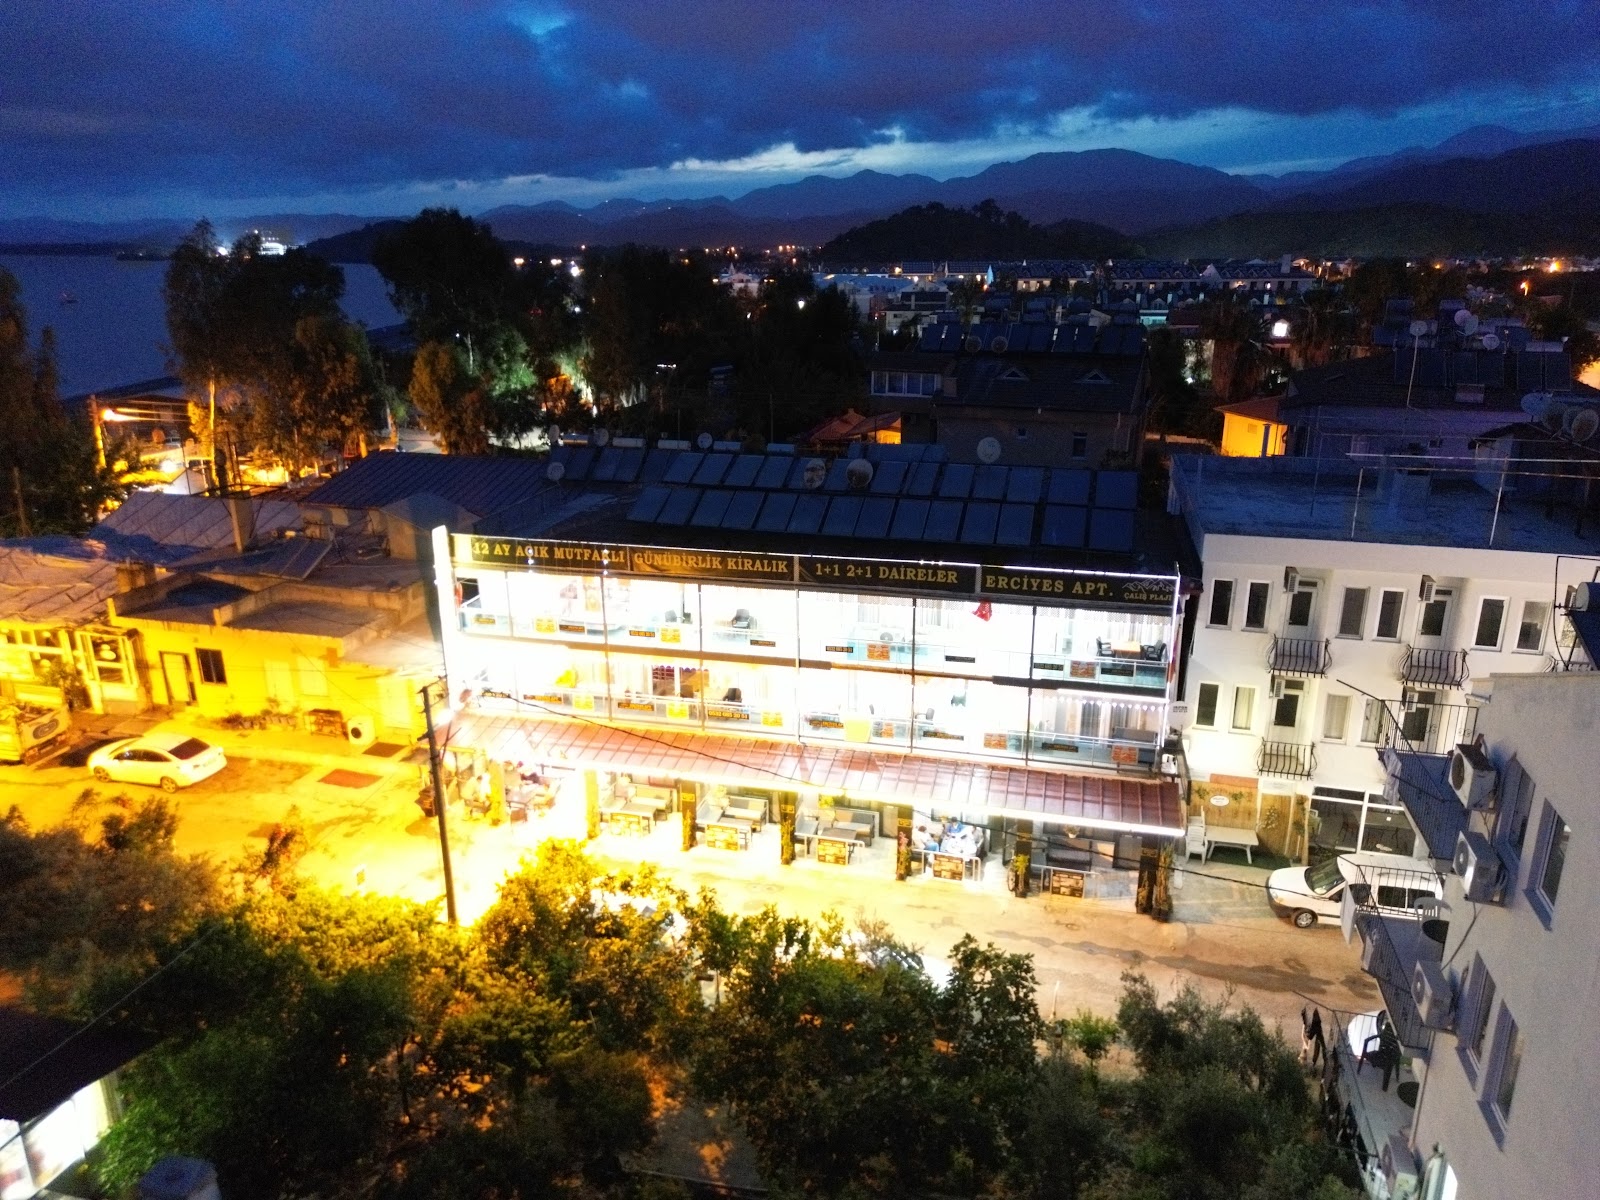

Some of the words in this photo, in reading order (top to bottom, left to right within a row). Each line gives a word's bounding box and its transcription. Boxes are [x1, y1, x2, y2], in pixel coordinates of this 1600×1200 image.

[472, 542, 490, 555] 12
[493, 543, 512, 556] AY
[516, 545, 550, 559] AÇIK
[553, 547, 625, 563] MUTFAKLI
[634, 550, 722, 569] GÜNÜBİRLİK
[727, 556, 789, 573] KİRALIK
[815, 563, 841, 577] 1+1
[846, 564, 873, 578] 2+1
[879, 565, 958, 584] DAİRELER
[985, 575, 1064, 593] ERCİYES
[1072, 581, 1114, 597] APT.
[1123, 592, 1148, 601] ÇALIŞ
